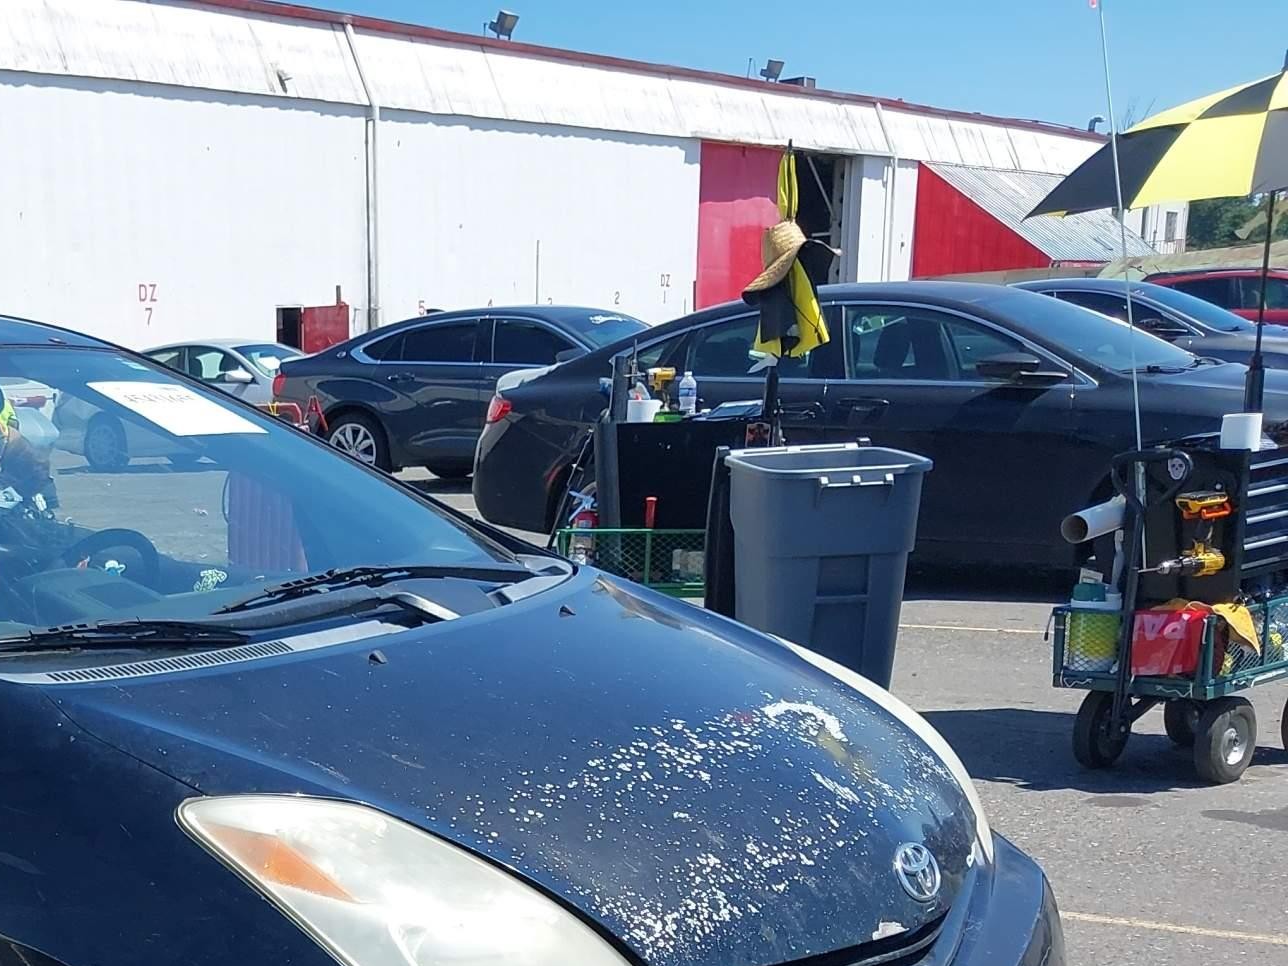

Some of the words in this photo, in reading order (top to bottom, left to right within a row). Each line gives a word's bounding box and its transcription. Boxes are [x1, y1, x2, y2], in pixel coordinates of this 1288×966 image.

[660, 273, 671, 287] DZ
[139, 283, 158, 302] DZ
[614, 291, 620, 304] 2
[418, 299, 425, 316] 5
[144, 307, 153, 326] 7
